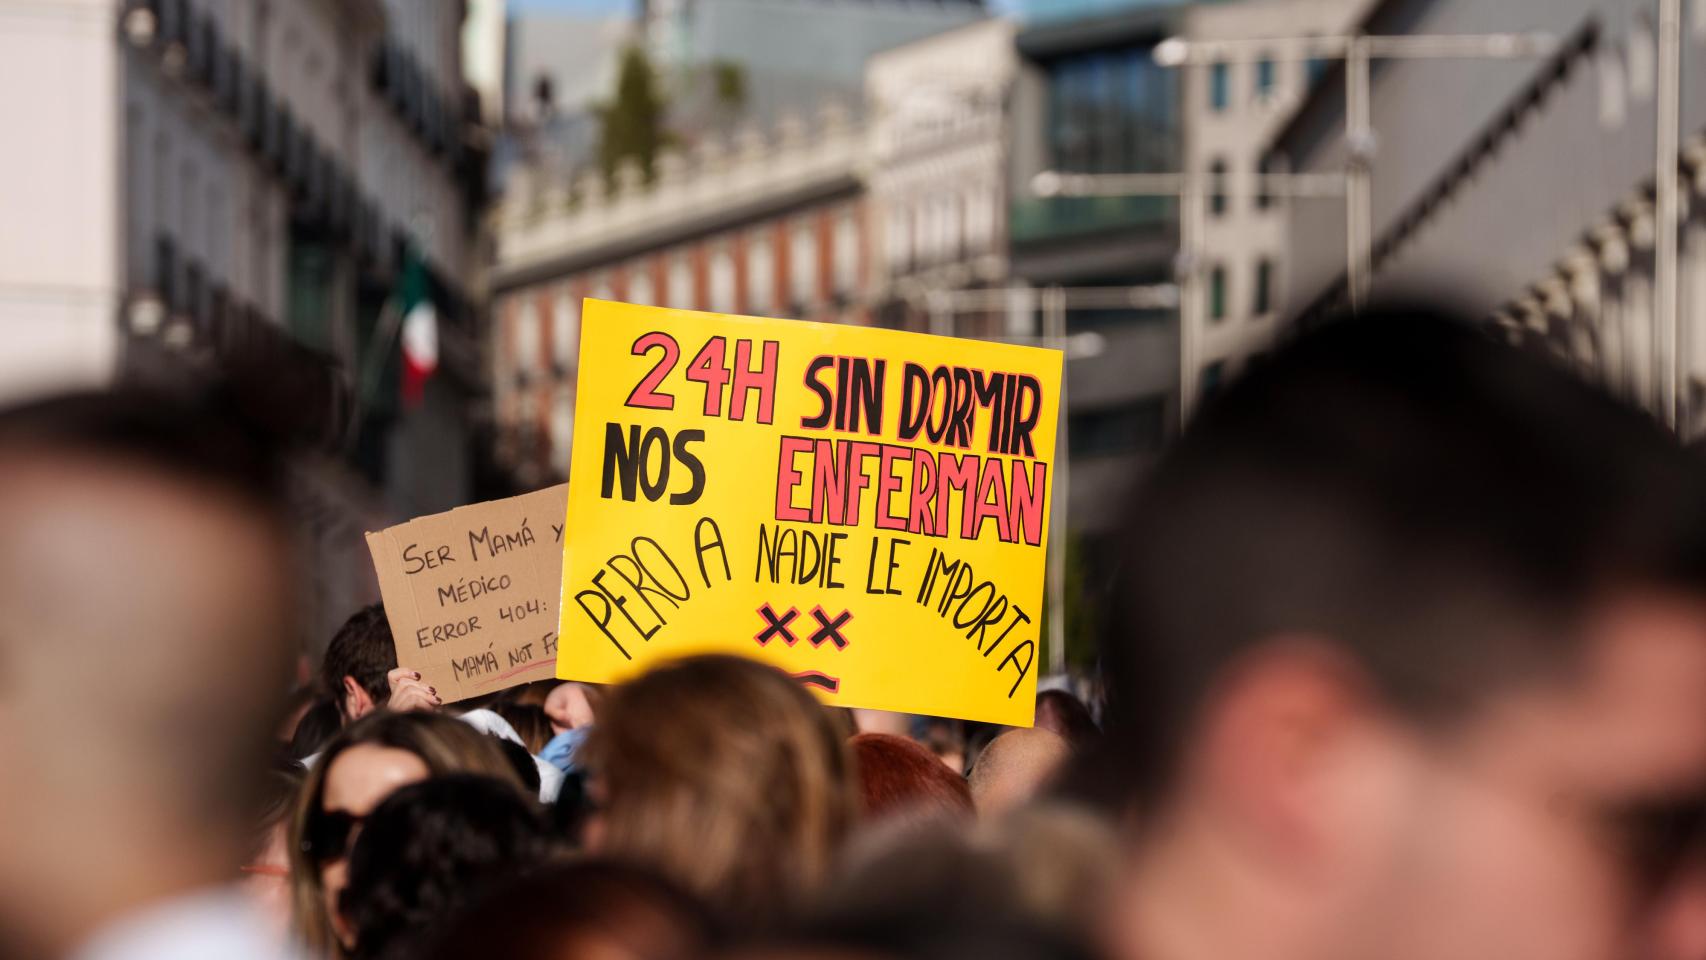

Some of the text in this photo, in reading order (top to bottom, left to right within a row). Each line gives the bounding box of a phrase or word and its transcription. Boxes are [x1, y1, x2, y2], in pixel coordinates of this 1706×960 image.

[624, 331, 1043, 459] 24H SIN DORMIR
[601, 422, 1047, 546] NOS ENFERMAN
[403, 517, 563, 575] SER MAMÁ Y
[416, 600, 548, 649] ERROR 404:
[574, 516, 1035, 699] PERO A NADIE LE IMPORTA
[451, 642, 499, 682] MAMÁ
[508, 643, 533, 668] NOT
